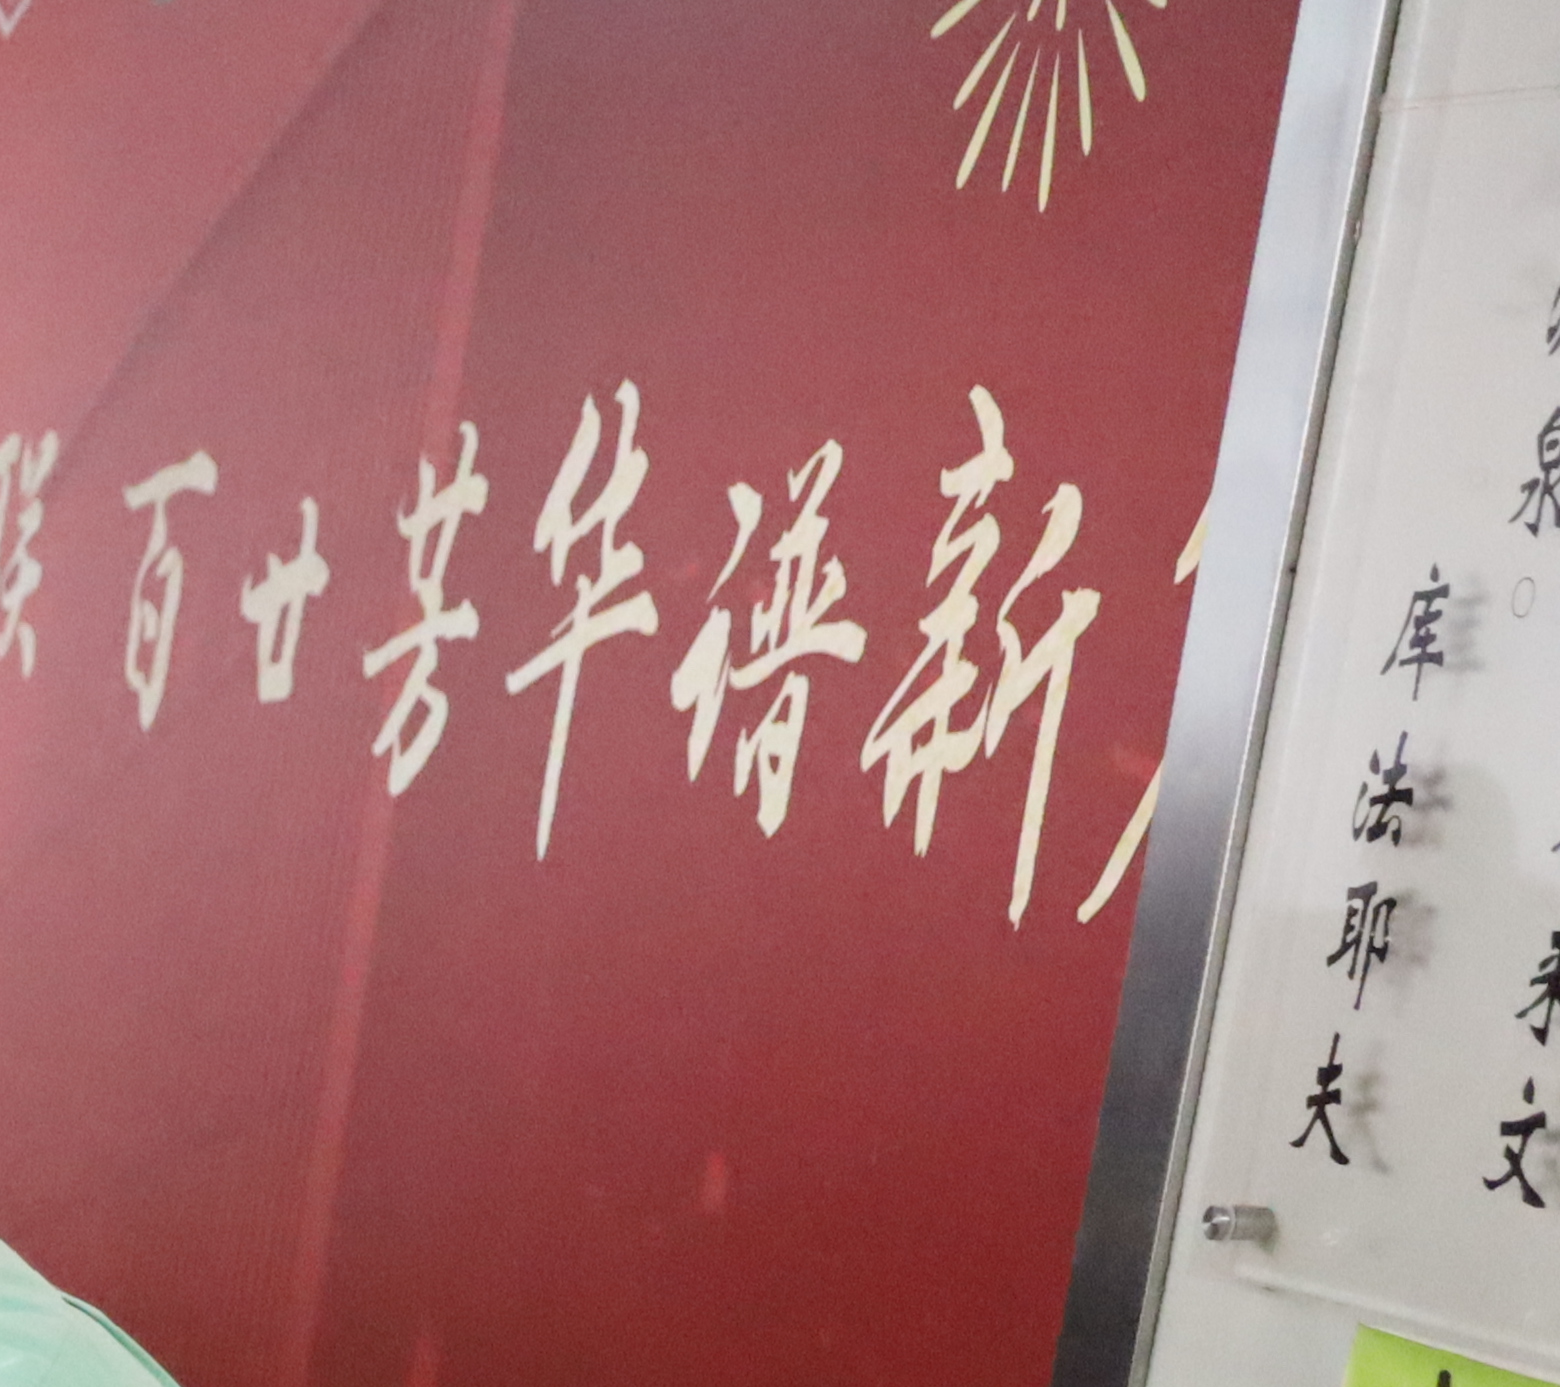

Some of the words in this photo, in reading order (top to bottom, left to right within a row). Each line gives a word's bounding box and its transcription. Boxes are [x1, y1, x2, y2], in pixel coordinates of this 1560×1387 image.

[124, 378, 1210, 932] 百廿芳华谱新
[1288, 562, 1450, 1166] 库法耶夫
